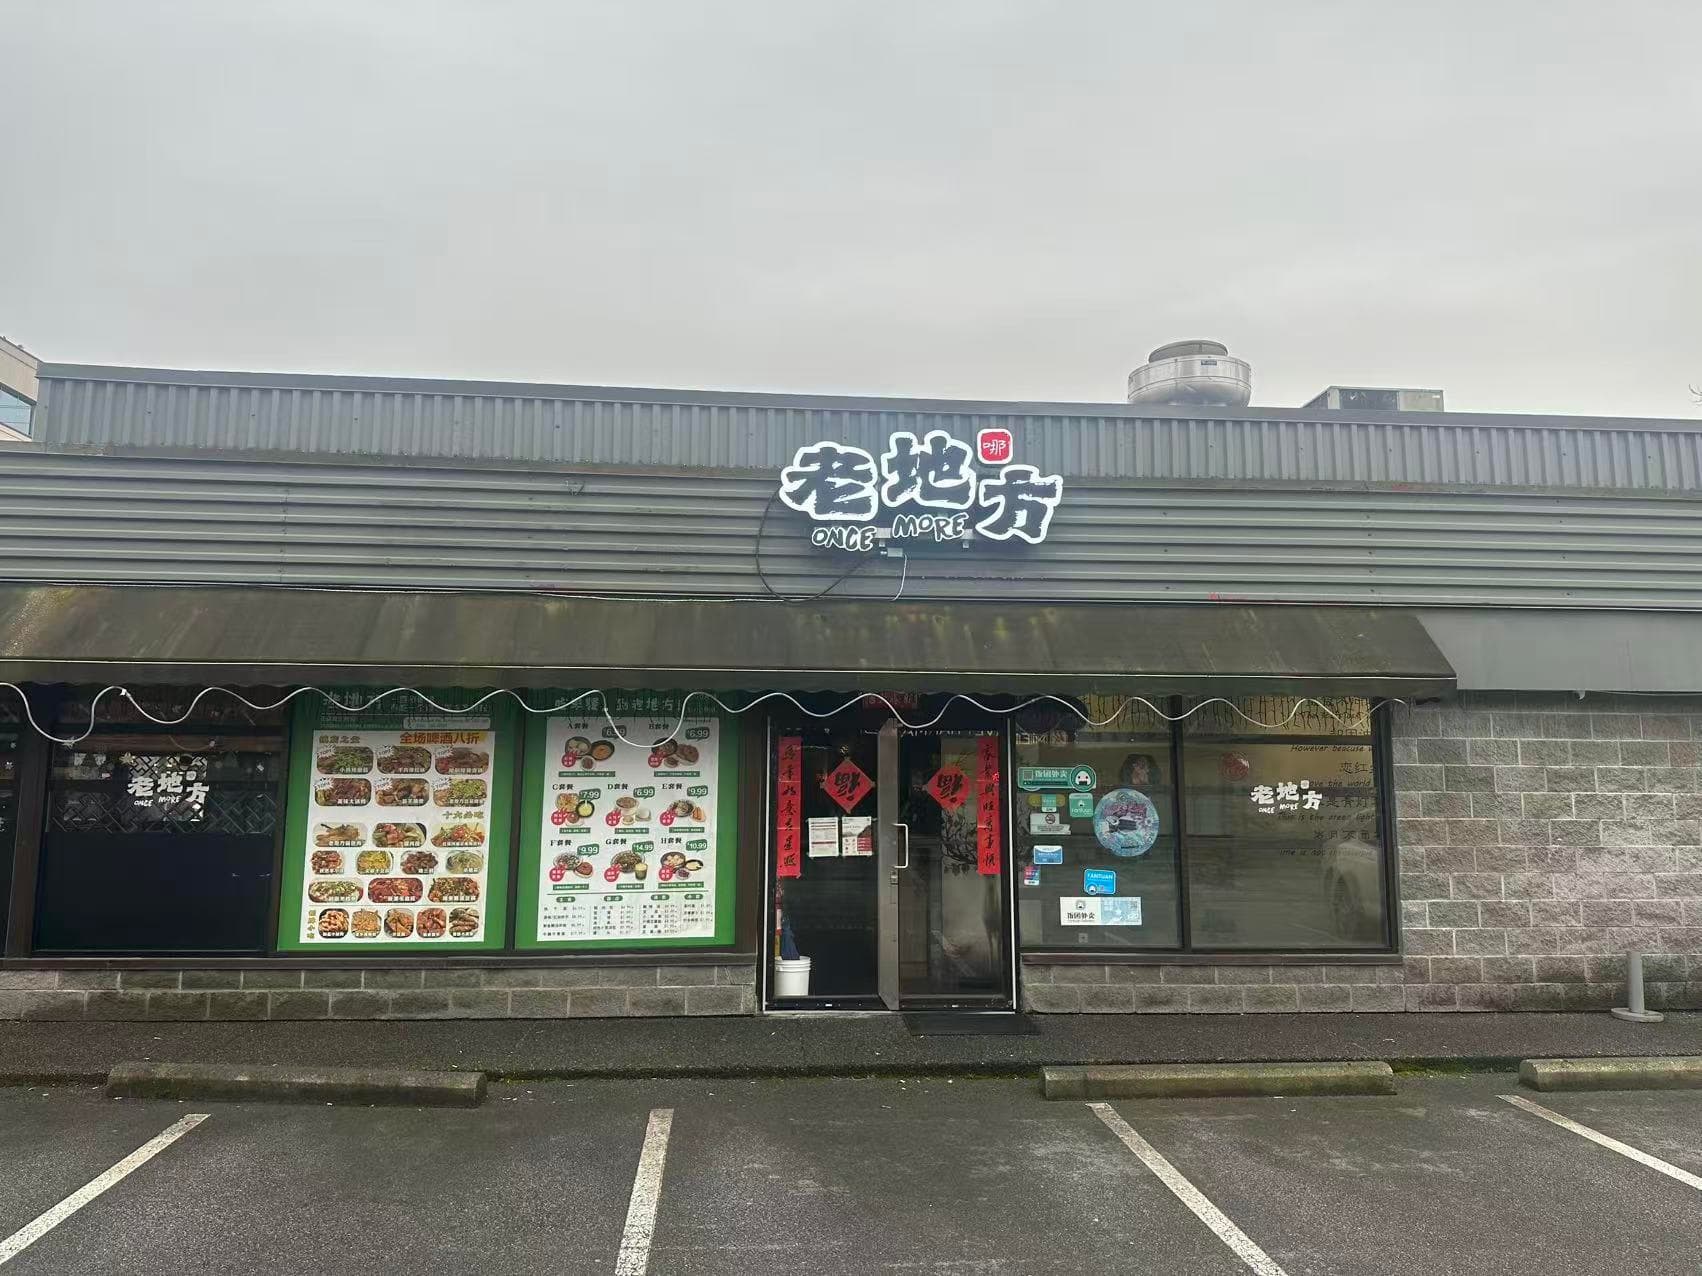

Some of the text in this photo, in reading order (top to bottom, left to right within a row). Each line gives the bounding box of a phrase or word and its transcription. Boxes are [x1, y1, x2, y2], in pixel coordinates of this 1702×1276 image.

[779, 430, 1063, 544] 老地方
[812, 512, 969, 551] ONCE MORE
[400, 732, 479, 745] 全场啤酒八折
[127, 771, 209, 804] 老地方
[1250, 782, 1322, 810] 老地方
